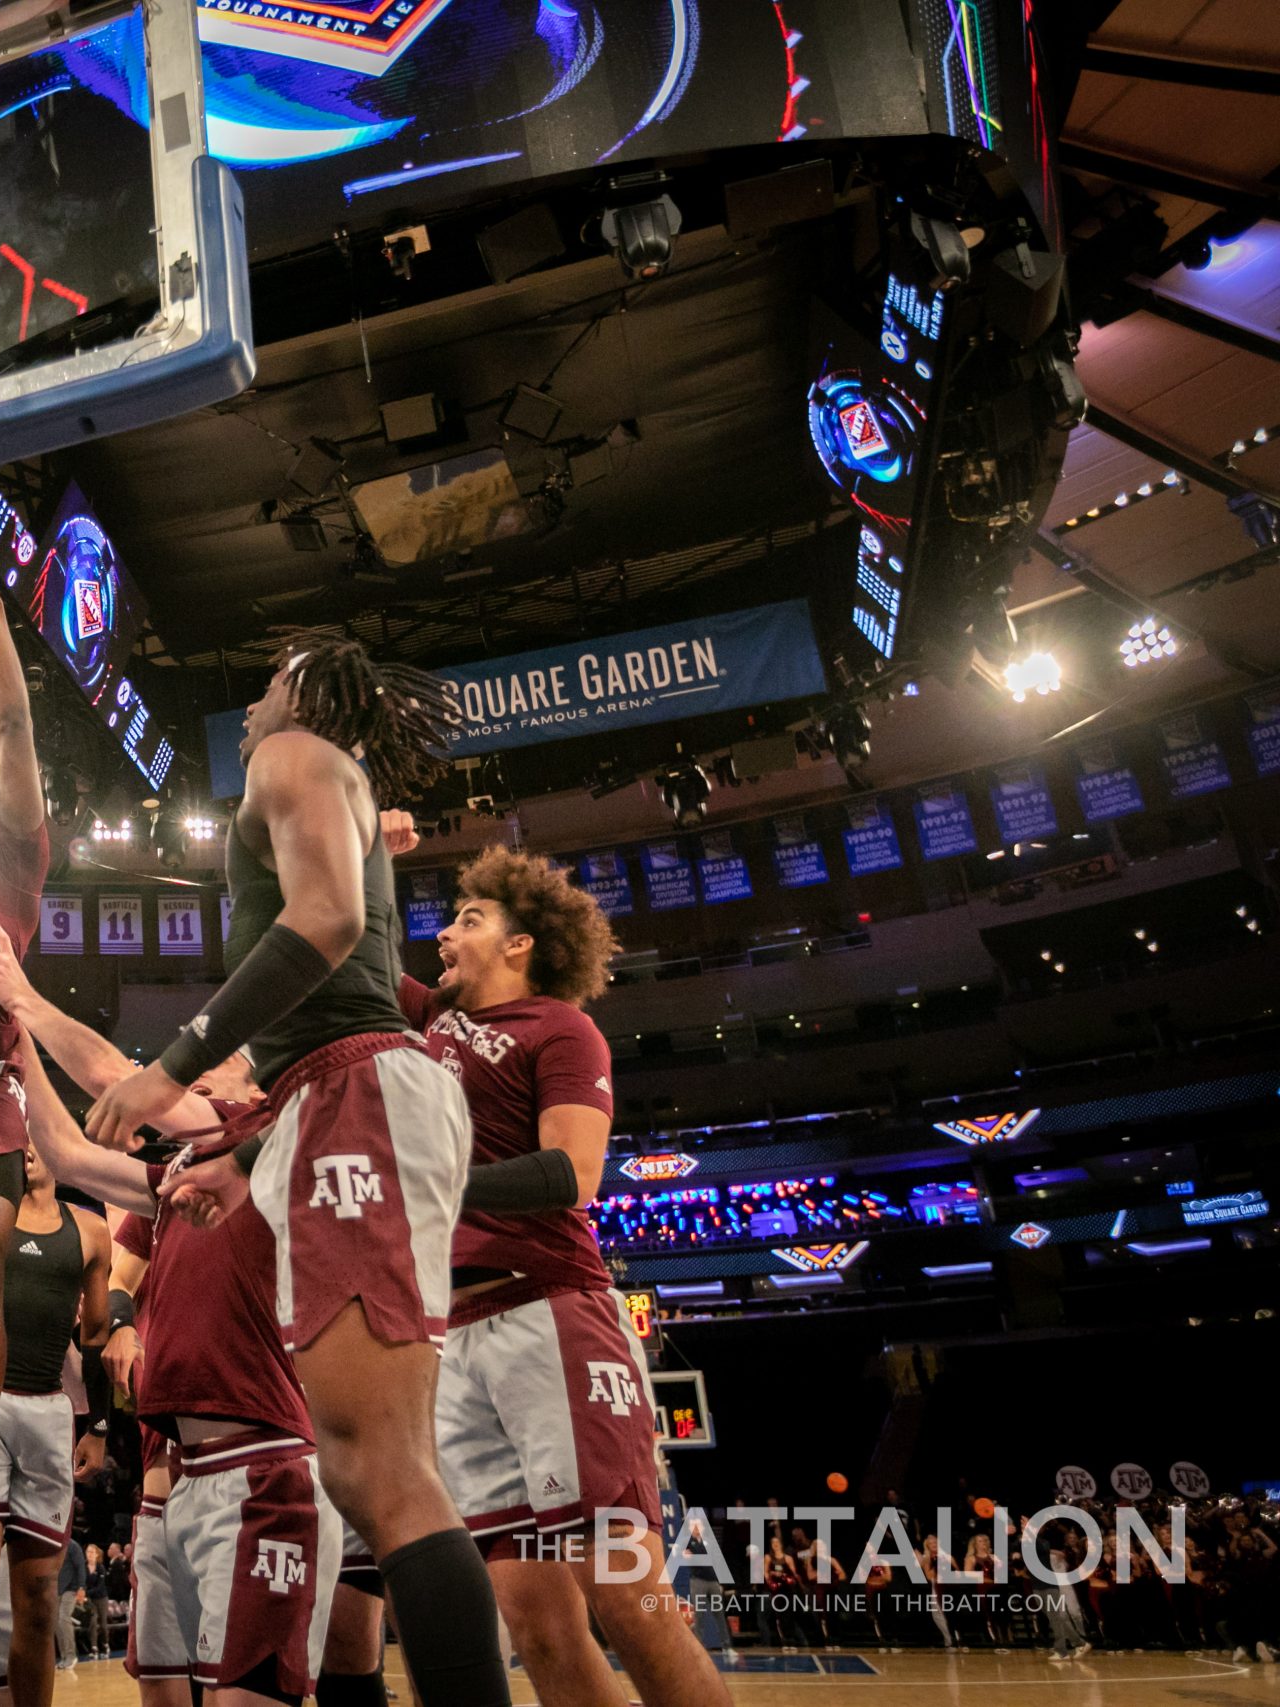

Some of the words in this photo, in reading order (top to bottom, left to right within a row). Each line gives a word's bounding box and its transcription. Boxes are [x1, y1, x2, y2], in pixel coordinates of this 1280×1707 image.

[204, 0, 367, 36] TOURNAMENT
[440, 666, 570, 726] SQUARE
[577, 637, 720, 701] GARDEN
[468, 721, 513, 740] MOST
[520, 708, 589, 729] FAMOUS
[596, 697, 653, 717] ARENA
[1080, 768, 1132, 791] 1993-94
[1171, 774, 1229, 796] CHAMPIONS
[1087, 784, 1130, 800] ATLANTIC
[1091, 791, 1131, 809] DIVISION
[997, 792, 1048, 811] 1991-92
[1087, 798, 1142, 820] CHAMPIONS
[921, 811, 966, 829] 1991-92
[1003, 804, 1047, 821] REGULAR
[1002, 820, 1057, 839] CHAMPIONS
[1009, 814, 1046, 830] SEASON
[847, 827, 892, 845] 1989-90
[927, 825, 963, 837] PATRICK
[855, 841, 888, 854] PATRICK
[924, 839, 976, 856] CHAMPIONS
[929, 833, 966, 847] DIVISION
[775, 844, 819, 859] 1941-42
[856, 849, 891, 862] DIVISION
[702, 859, 744, 874] 1931-32
[779, 856, 818, 868] REGULAR
[851, 855, 901, 872] CHAMPIONS
[648, 868, 689, 882] 1926-27
[705, 871, 744, 884] AMERICAN
[779, 871, 826, 886] CHAMPIONS
[783, 865, 817, 876] SEASON
[587, 878, 628, 893] 1993-94
[650, 880, 690, 892] AMERICAN
[705, 886, 751, 900] CHAMPIONS
[709, 879, 742, 892] DIVISION
[650, 895, 696, 908] CHAMPIONS
[655, 889, 688, 899] DIVISION
[409, 900, 448, 912] 1927-28
[601, 899, 617, 908] CUP
[413, 911, 444, 921] STANLEY
[422, 920, 437, 928] CUP
[52, 911, 71, 940] 9
[107, 911, 135, 941] 11
[166, 912, 194, 941] 11
[947, 1121, 988, 1144] AMENT
[994, 1117, 1018, 1142] NEW
[640, 1160, 679, 1174] NIT
[1184, 1210, 1215, 1222] MADISON
[1214, 1207, 1240, 1218] SQUARE
[1240, 1203, 1267, 1214] GARDEN
[1021, 1230, 1040, 1240] NIT
[784, 1247, 820, 1270] AMENT
[826, 1248, 848, 1269] NEW
